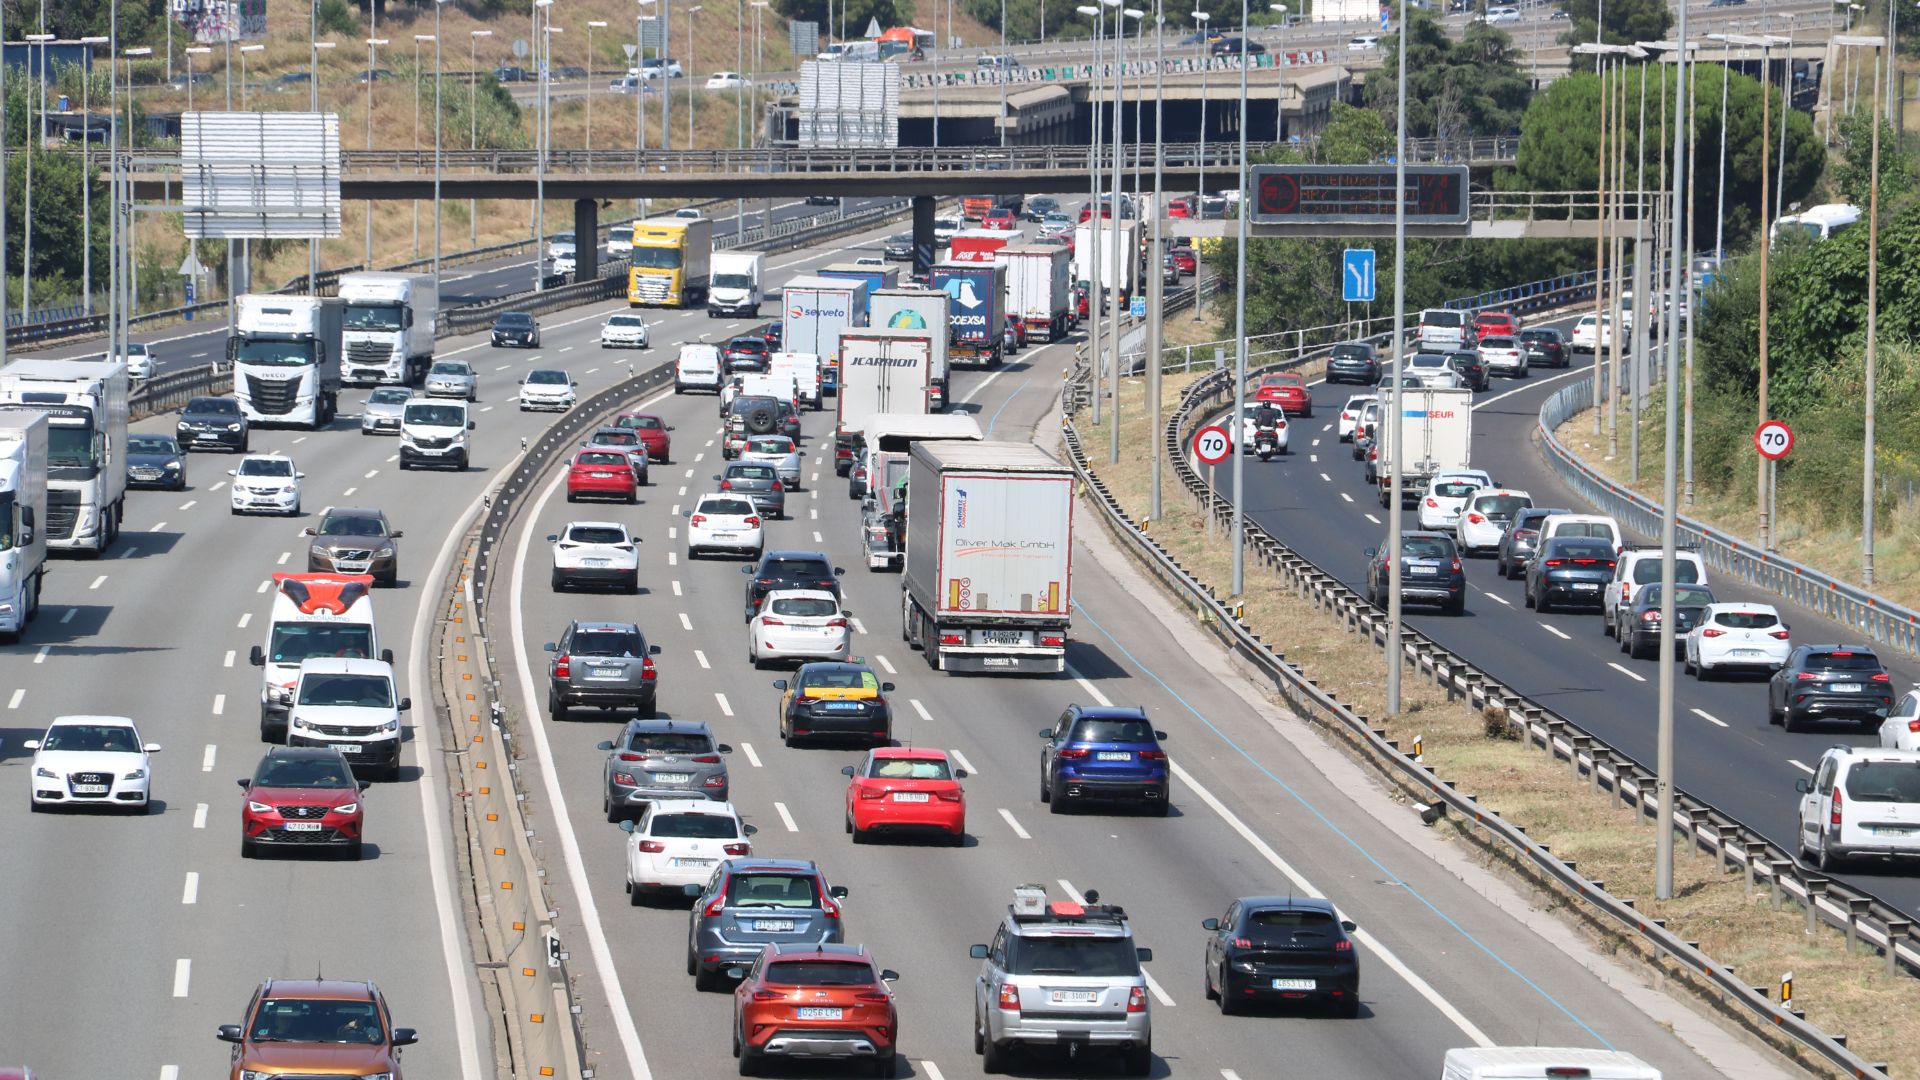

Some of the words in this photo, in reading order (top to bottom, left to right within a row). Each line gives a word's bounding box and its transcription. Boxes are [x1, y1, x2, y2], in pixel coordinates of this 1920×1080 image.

[805, 308, 845, 318] serveto
[950, 314, 986, 326] COEXSA
[850, 356, 918, 368] JCARRION
[1428, 410, 1454, 419] SEUR
[1203, 438, 1224, 452] 70
[1763, 433, 1785, 447] 70
[955, 538, 988, 547] Oliver
[991, 540, 1017, 549] Mak
[1020, 541, 1055, 550] GmbH
[802, 1008, 823, 1017] 0256
[825, 1009, 841, 1017] LPC
